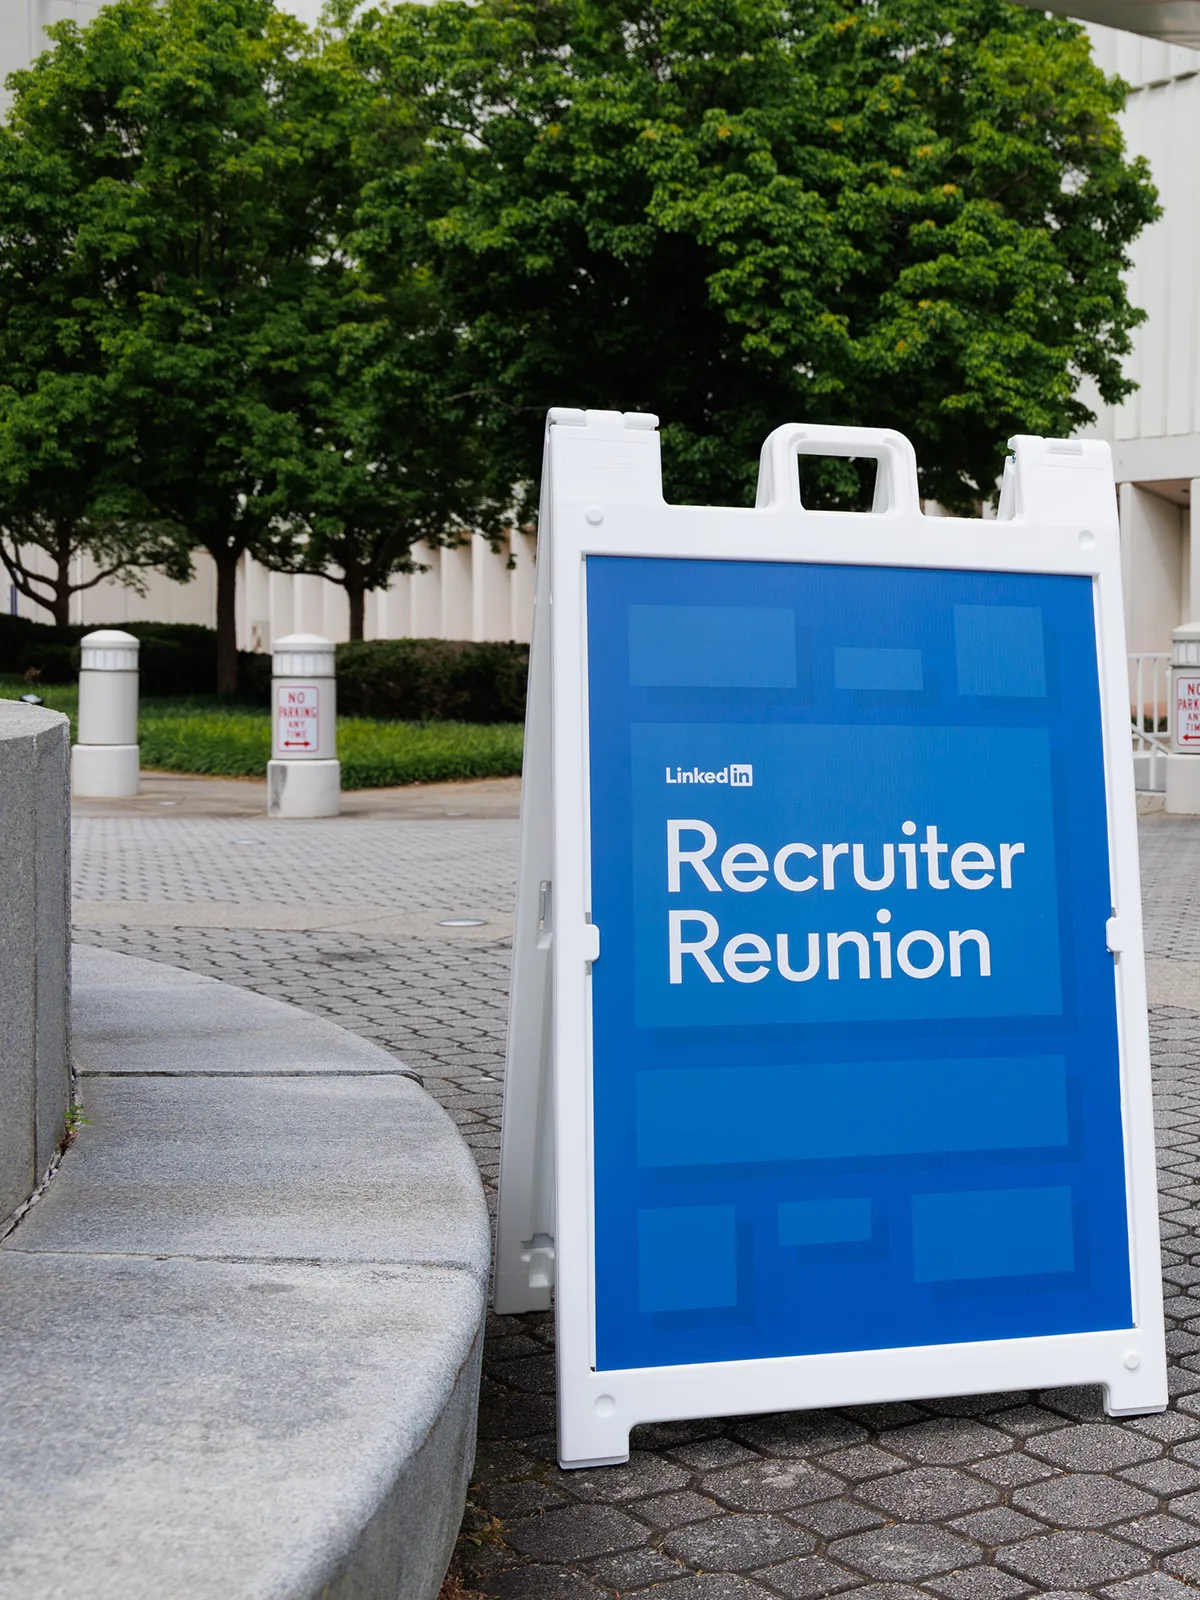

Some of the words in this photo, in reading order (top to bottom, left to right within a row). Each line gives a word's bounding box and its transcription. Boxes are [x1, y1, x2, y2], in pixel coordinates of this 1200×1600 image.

[287, 692, 306, 704] NO
[279, 706, 317, 718] PARKING
[288, 720, 306, 728] ANY
[667, 819, 1025, 892] Recruiter
[669, 908, 991, 984] Reunion
